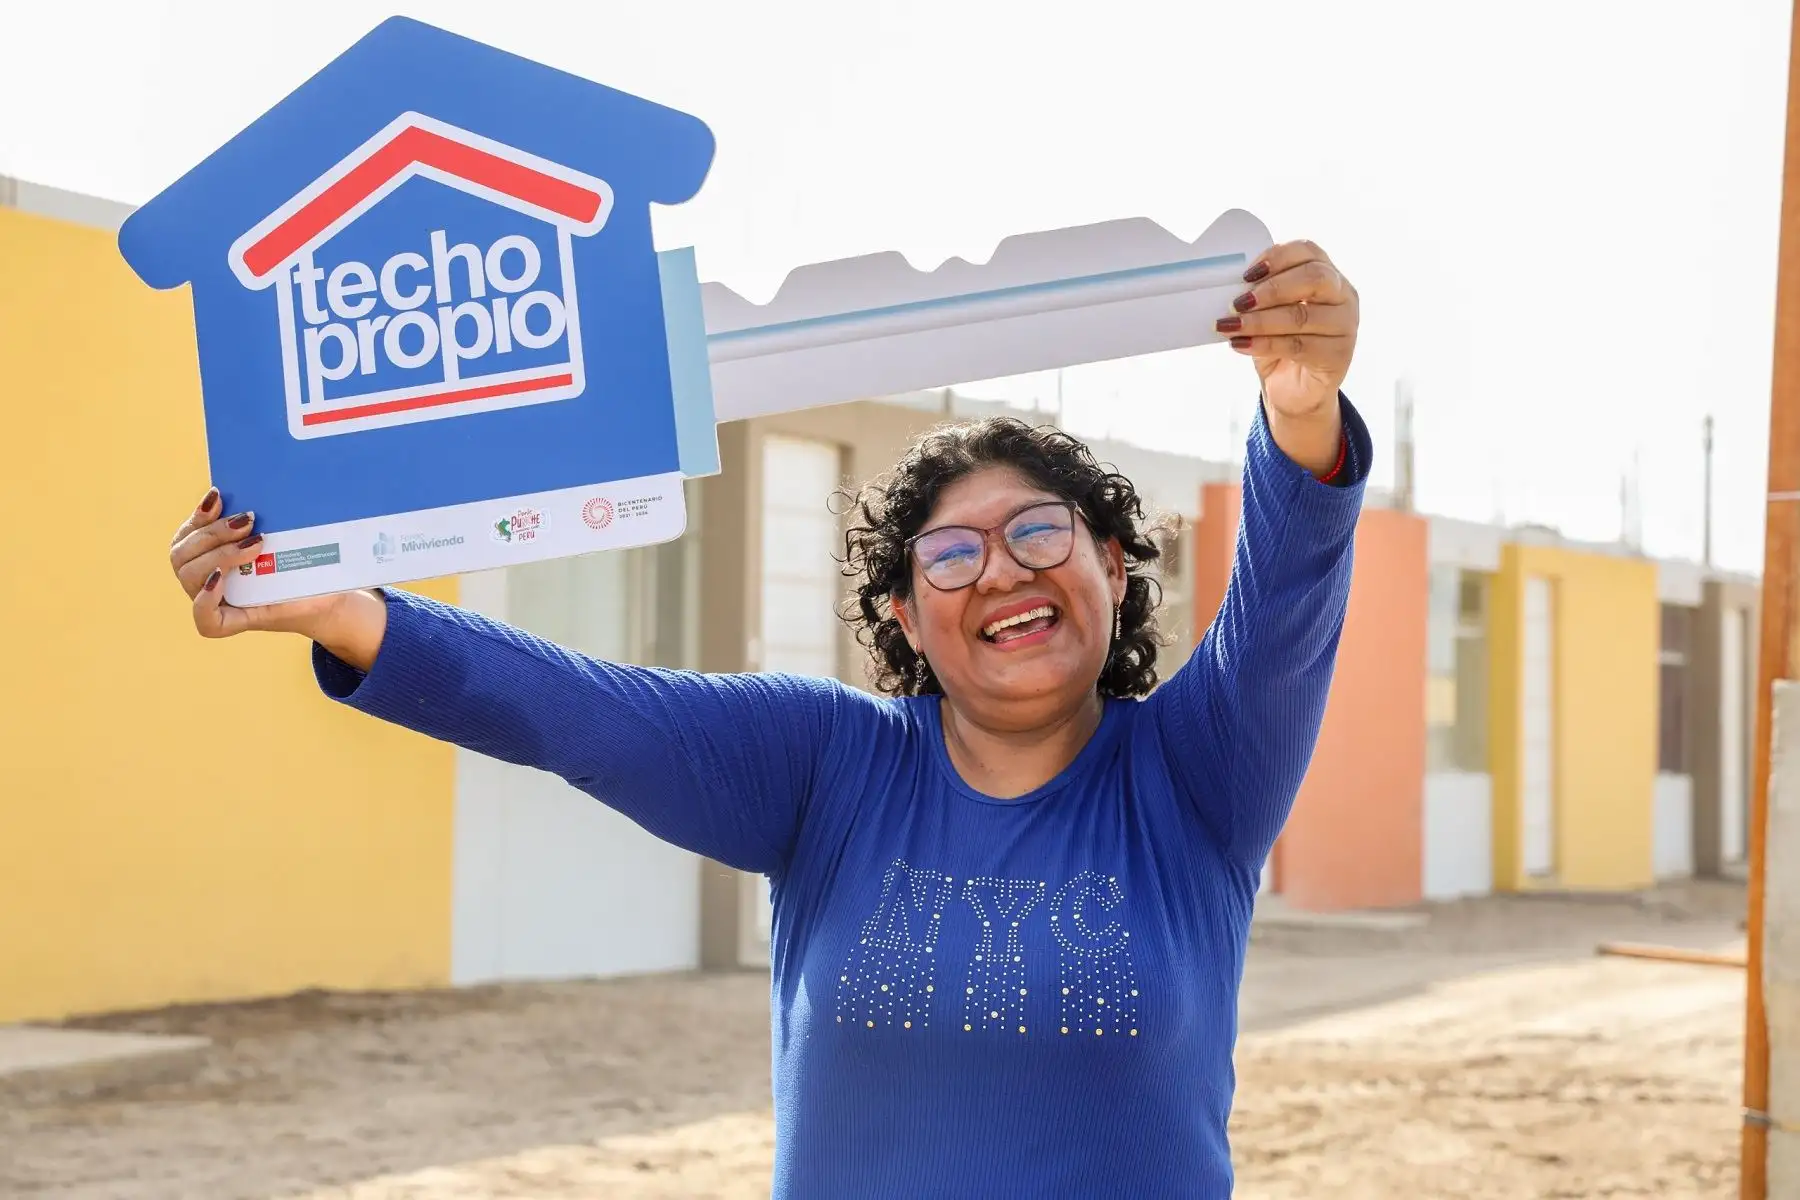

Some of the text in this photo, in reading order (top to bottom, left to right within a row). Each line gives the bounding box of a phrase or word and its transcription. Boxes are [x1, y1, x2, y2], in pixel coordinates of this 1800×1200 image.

[293, 229, 541, 325] techo
[303, 290, 567, 402] propio
[617, 496, 663, 507] BICENTENARIO
[631, 503, 648, 511] PERÚ
[401, 534, 464, 552] Mivivienda
[257, 560, 273, 569] PERÚ
